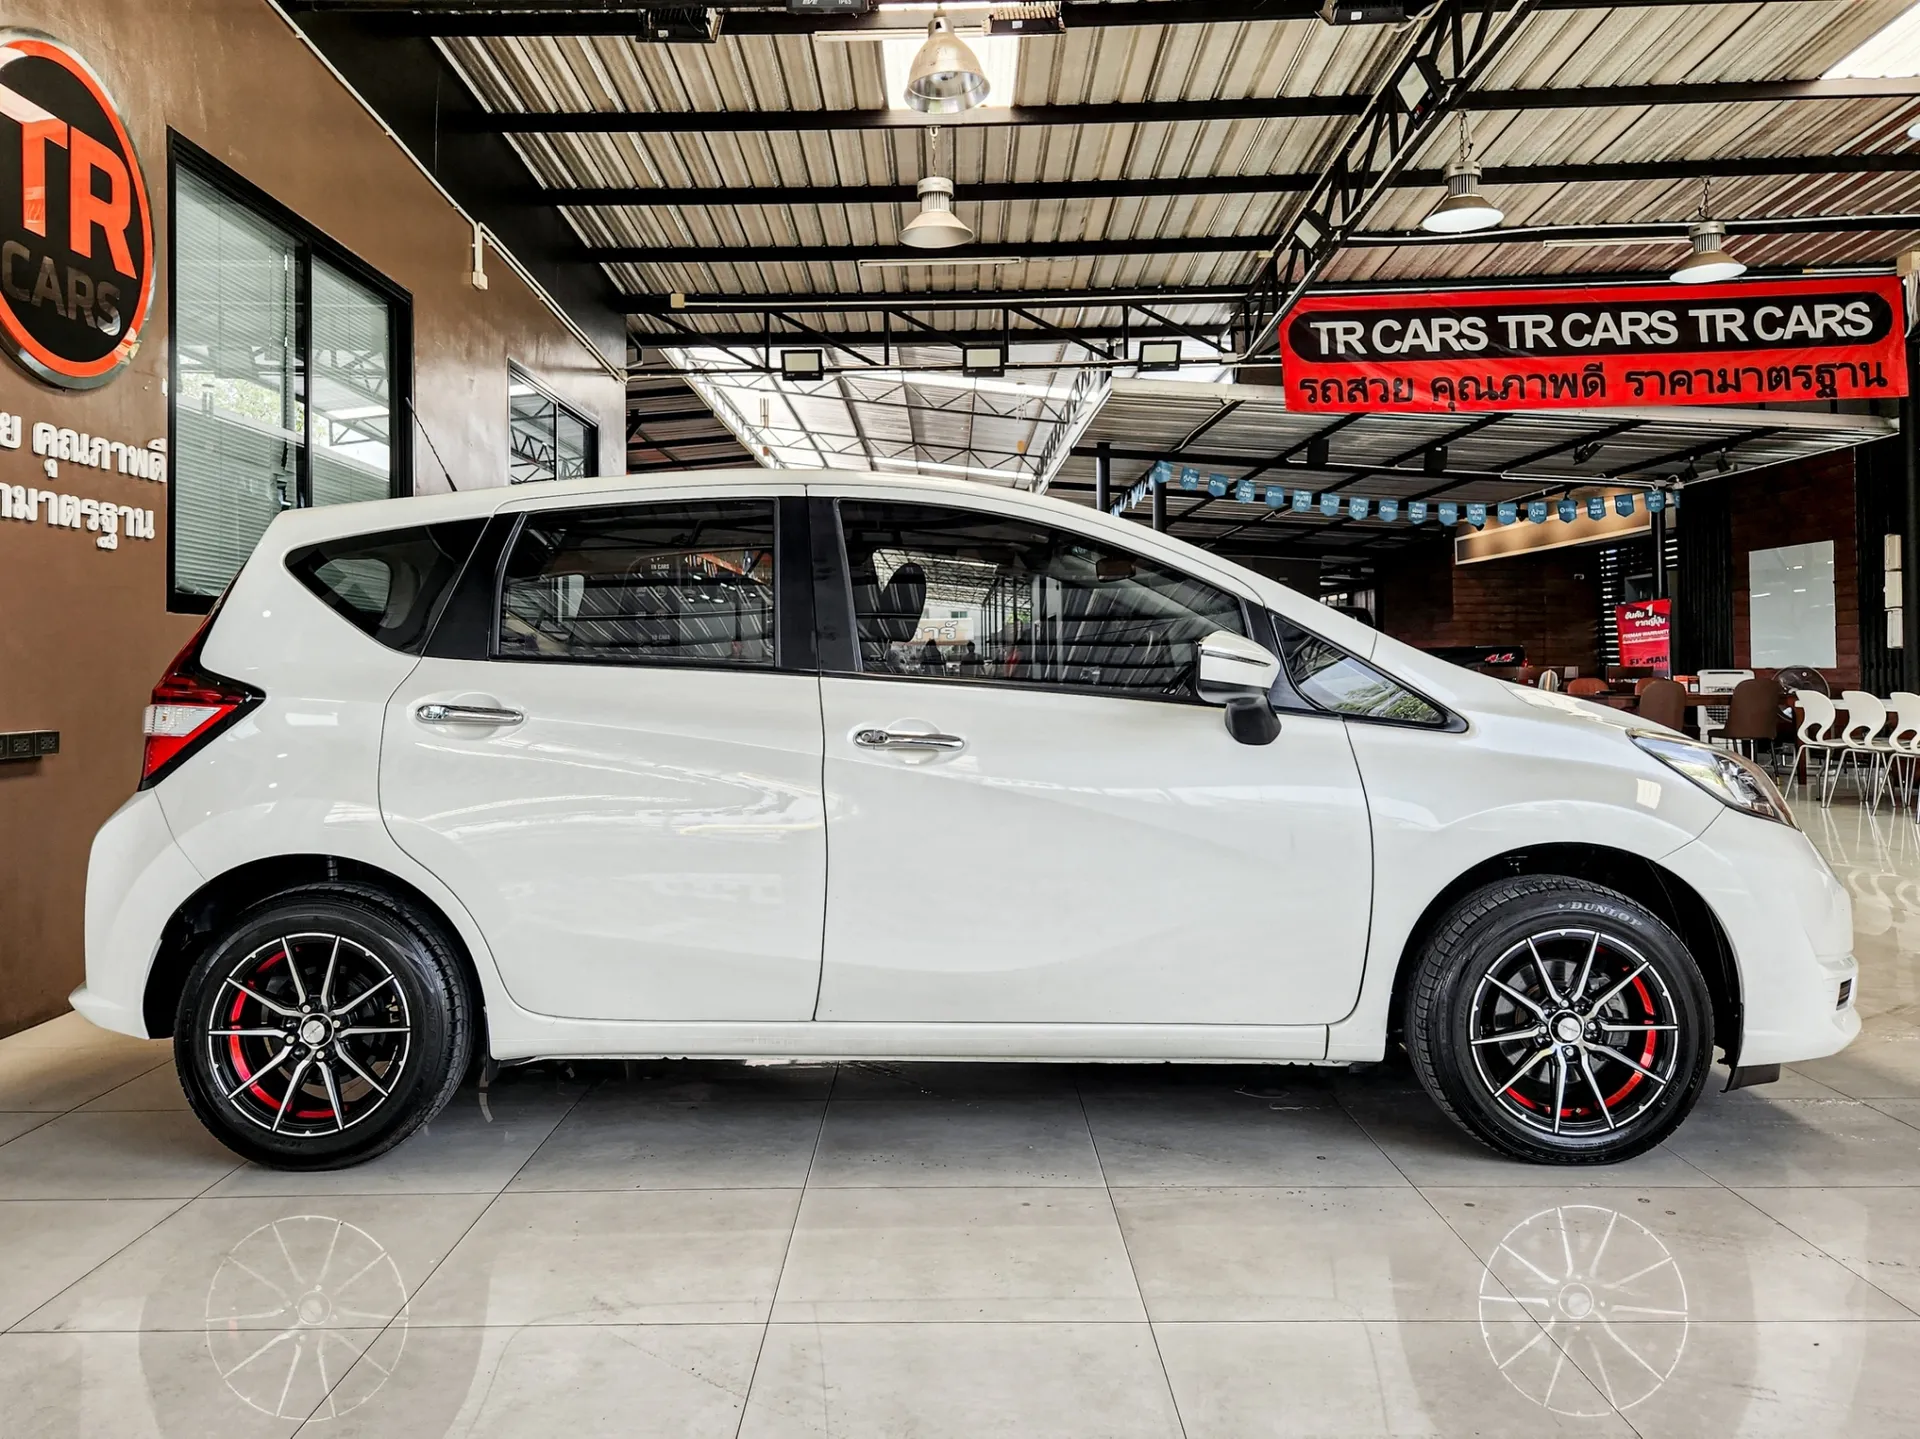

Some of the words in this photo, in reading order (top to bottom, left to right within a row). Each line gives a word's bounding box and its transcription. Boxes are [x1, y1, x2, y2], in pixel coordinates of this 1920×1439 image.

[0, 83, 137, 280] TR
[2, 239, 122, 337] CARS
[1309, 320, 1368, 356] TR
[1371, 316, 1489, 355] CARS
[1497, 314, 1558, 349] TR
[1561, 309, 1679, 348] CARS
[1688, 308, 1749, 343] TR
[1753, 301, 1874, 341] CARS
[1299, 376, 1414, 404] รถสวย
[1430, 362, 1606, 412] คุณภาพดี
[1625, 360, 1889, 399] ราคามาตรฐาน
[33, 422, 167, 483] คุณภาพดี
[1645, 604, 1654, 617] 1
[1570, 901, 1643, 926] DUNLOP
